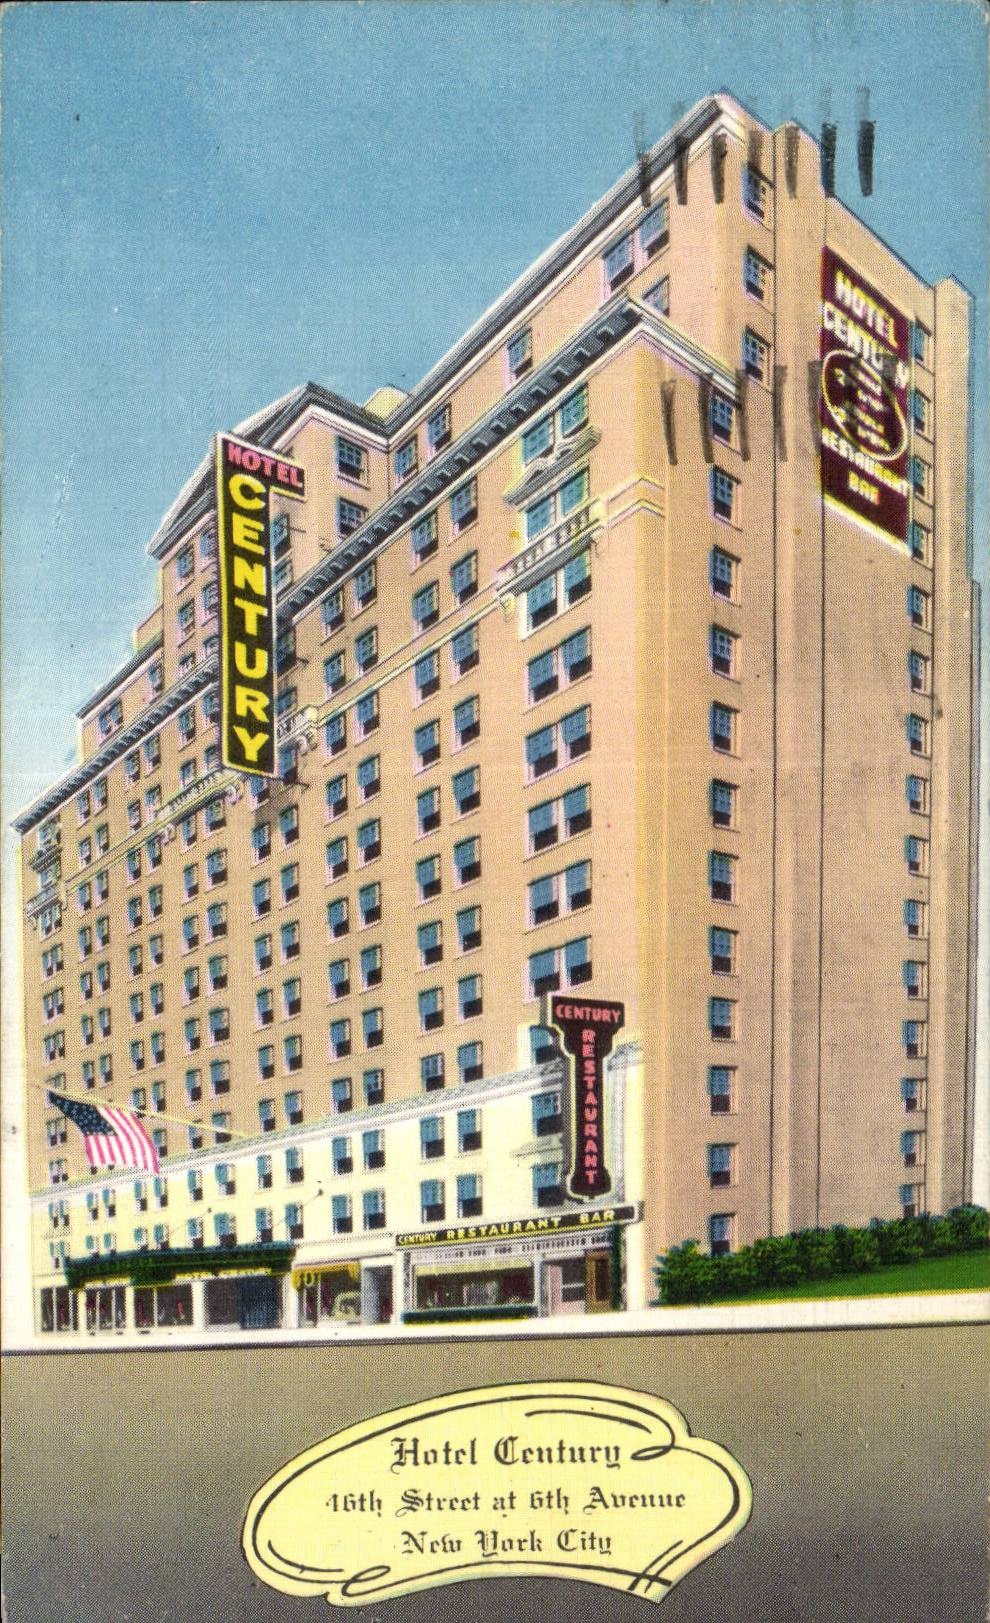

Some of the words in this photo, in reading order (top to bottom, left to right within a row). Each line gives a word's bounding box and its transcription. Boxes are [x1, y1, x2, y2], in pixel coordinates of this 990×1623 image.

[836, 270, 899, 350] HOTEL
[823, 302, 910, 389] CENTUY
[227, 442, 304, 488] HOTEL
[848, 471, 880, 505] BAR
[228, 473, 269, 762] CENTURY
[555, 1004, 621, 1023] CENTURY
[582, 1029, 598, 1184] RESTAURANT
[397, 1231, 437, 1245] CENTURY
[446, 1217, 562, 1240] RESTAURANT
[579, 1209, 616, 1225] BAR
[390, 1436, 477, 1474] Hotel
[494, 1436, 622, 1470] Century
[395, 1489, 480, 1517] Street
[492, 1490, 517, 1511] at
[529, 1489, 570, 1515] 6th
[583, 1487, 686, 1511] Avenue
[402, 1531, 462, 1555] New
[477, 1530, 543, 1557] York
[557, 1529, 612, 1556] City
